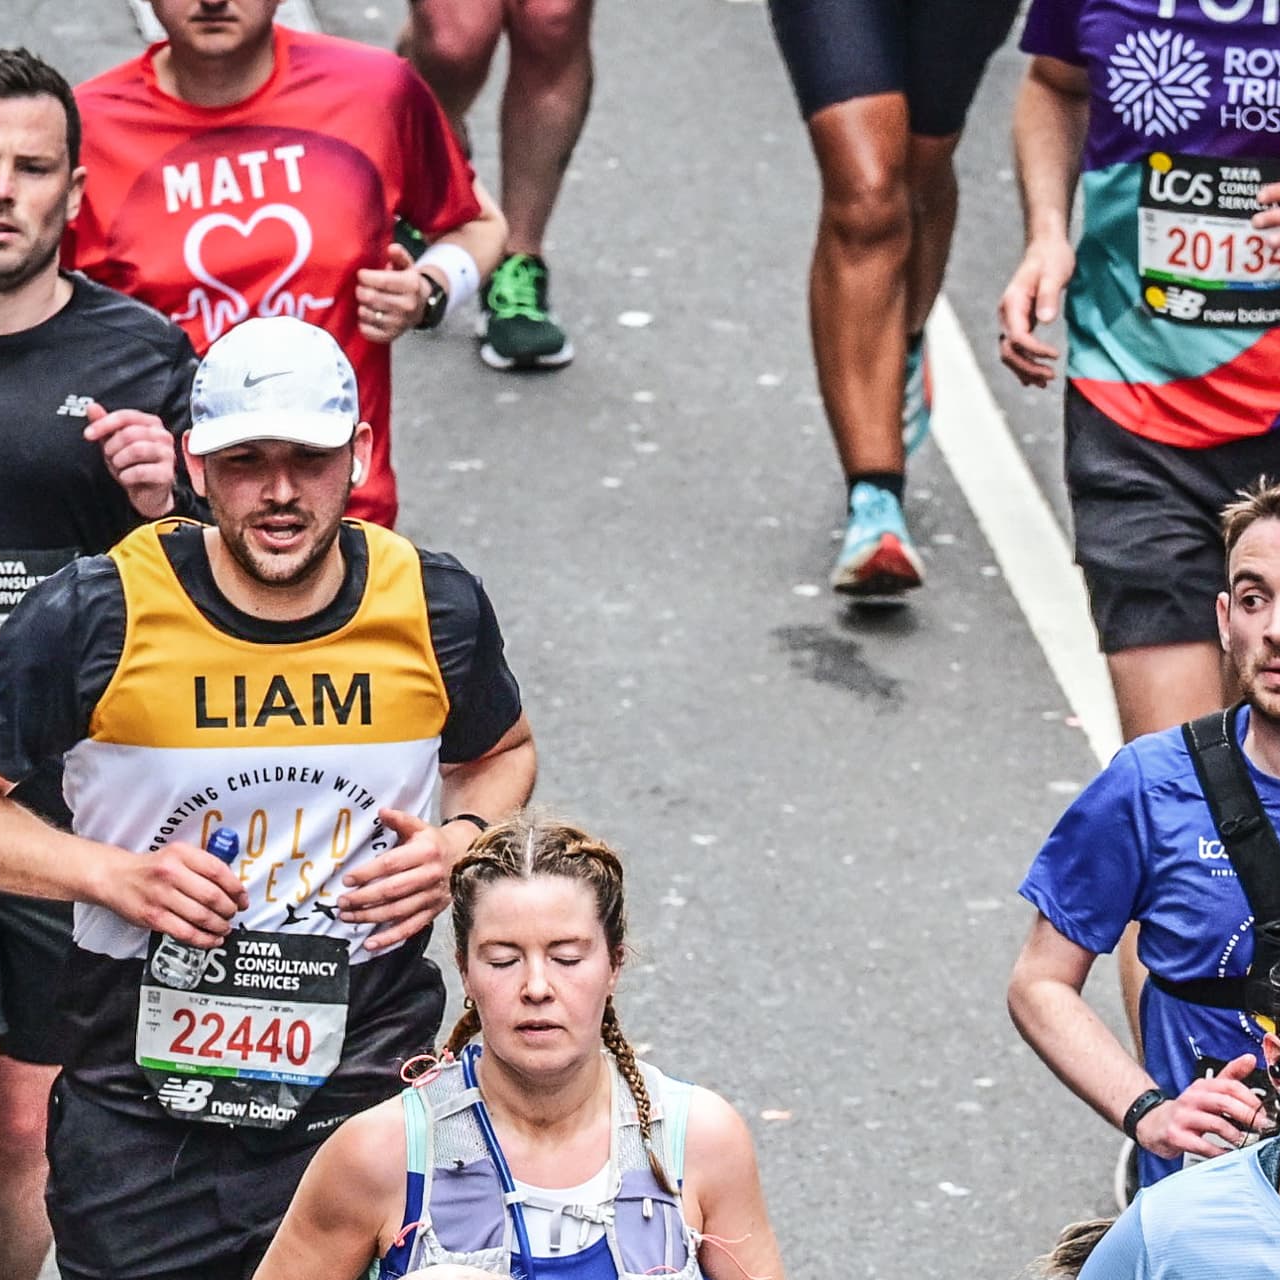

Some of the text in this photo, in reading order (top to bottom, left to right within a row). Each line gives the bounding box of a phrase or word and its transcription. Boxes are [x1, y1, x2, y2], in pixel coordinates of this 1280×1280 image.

[163, 145, 305, 213] MATT
[1219, 167, 1261, 181] TATA
[1203, 309, 1237, 323] new
[194, 673, 372, 728] LIAM
[227, 766, 375, 811] CHILDREN WITH
[237, 940, 283, 957] TATA
[234, 957, 338, 977] CONSULTANCY
[233, 972, 301, 991] SERVICES
[168, 1008, 312, 1066] 22440
[211, 1101, 246, 1117] new
